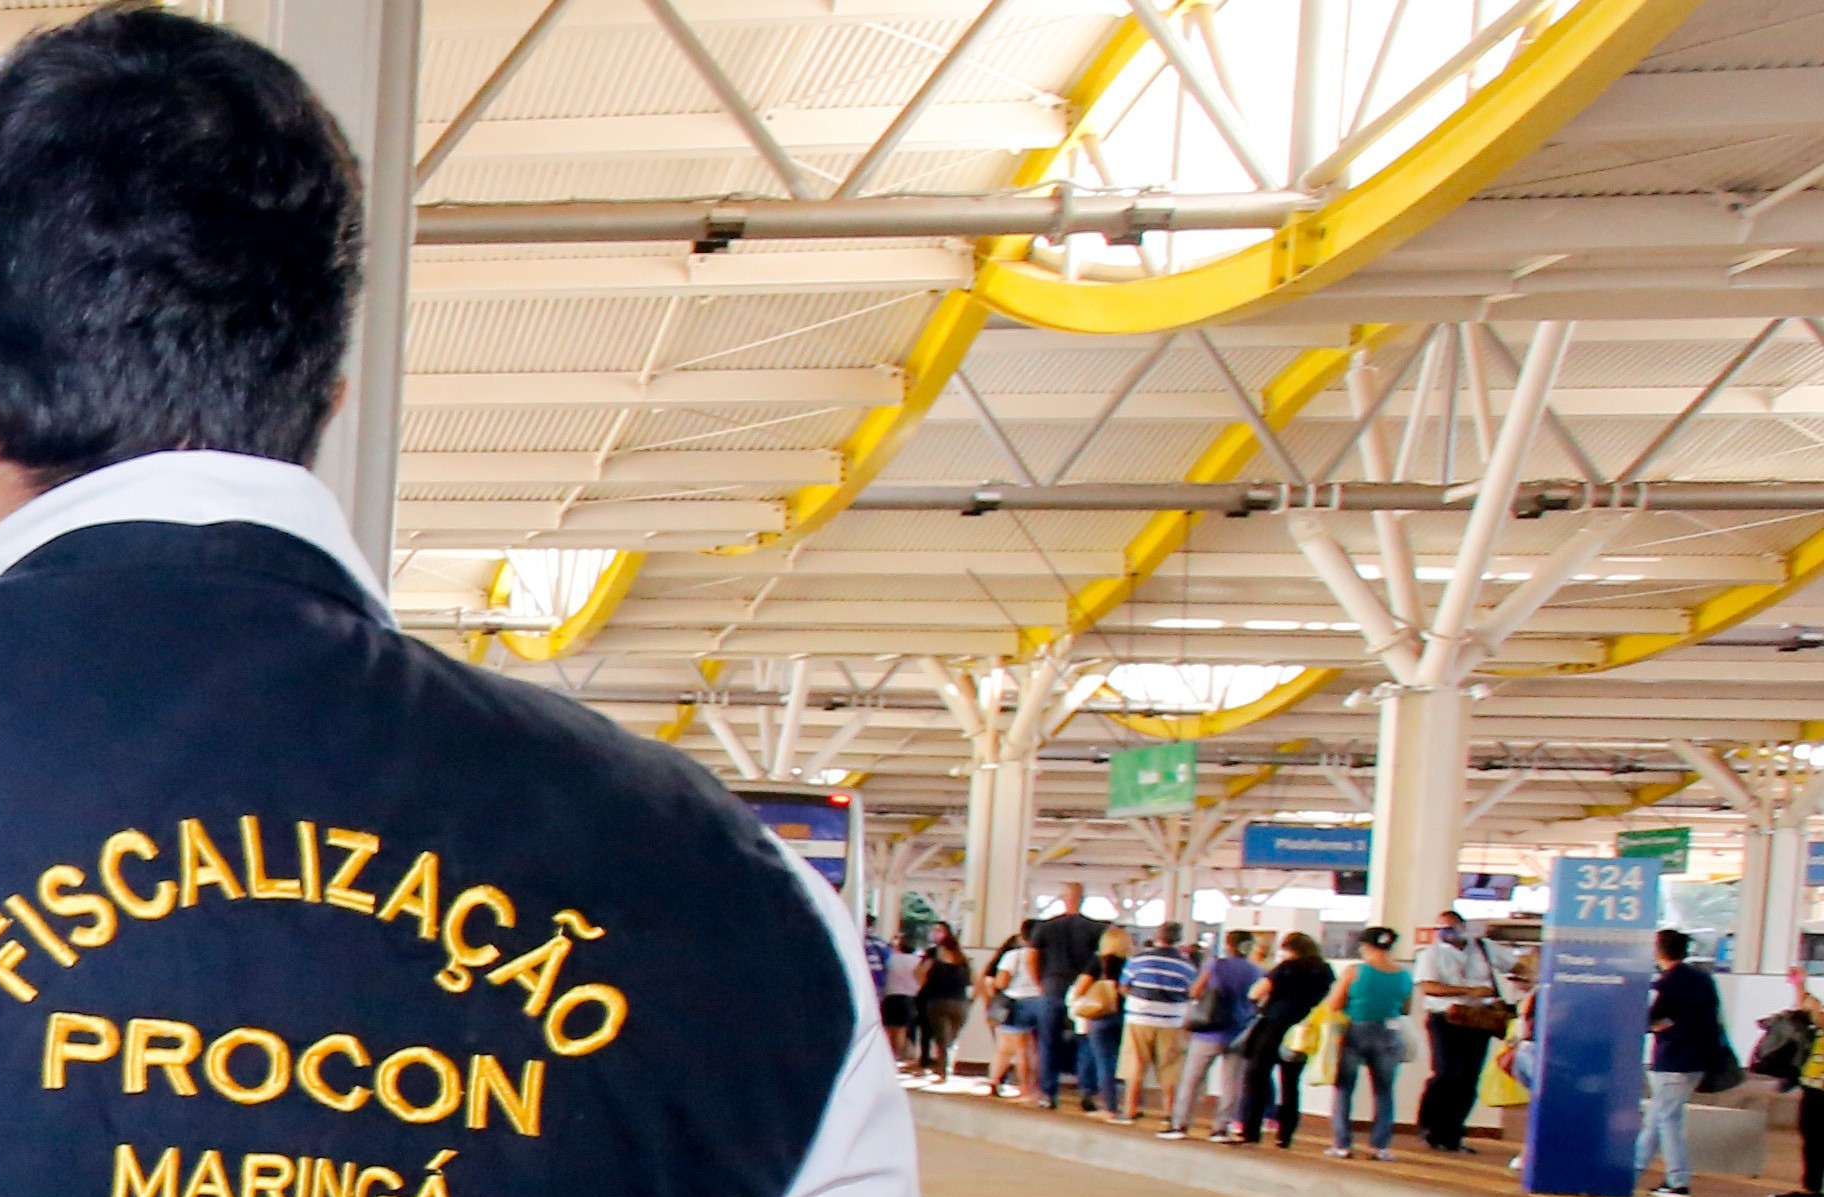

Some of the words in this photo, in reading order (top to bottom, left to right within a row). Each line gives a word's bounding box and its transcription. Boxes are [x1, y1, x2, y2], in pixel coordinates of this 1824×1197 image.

[1576, 865, 1643, 891] 324
[1575, 894, 1641, 922] 713
[41, 1011, 546, 1137] PROCON
